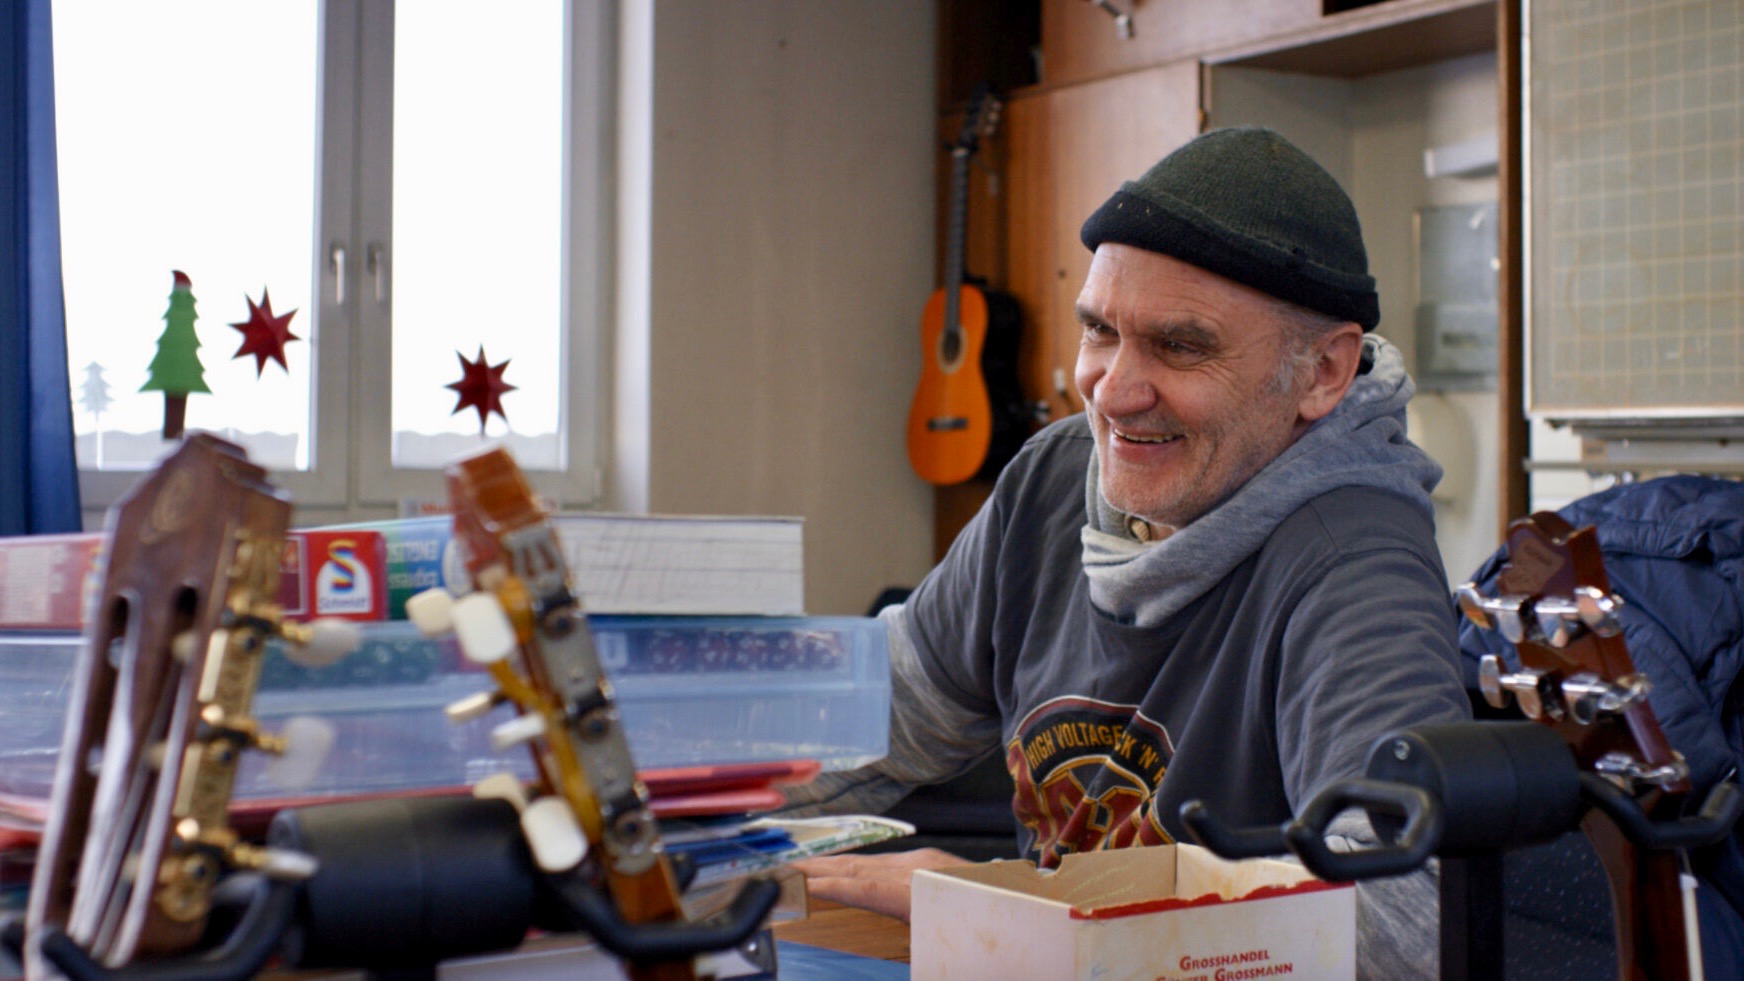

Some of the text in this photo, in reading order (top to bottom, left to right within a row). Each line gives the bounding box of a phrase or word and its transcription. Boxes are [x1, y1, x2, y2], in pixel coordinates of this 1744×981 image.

[1026, 729, 1056, 770] HIGH
[1180, 950, 1270, 971] GROSSHANDEL
[1214, 963, 1293, 981] GROSSMANN
